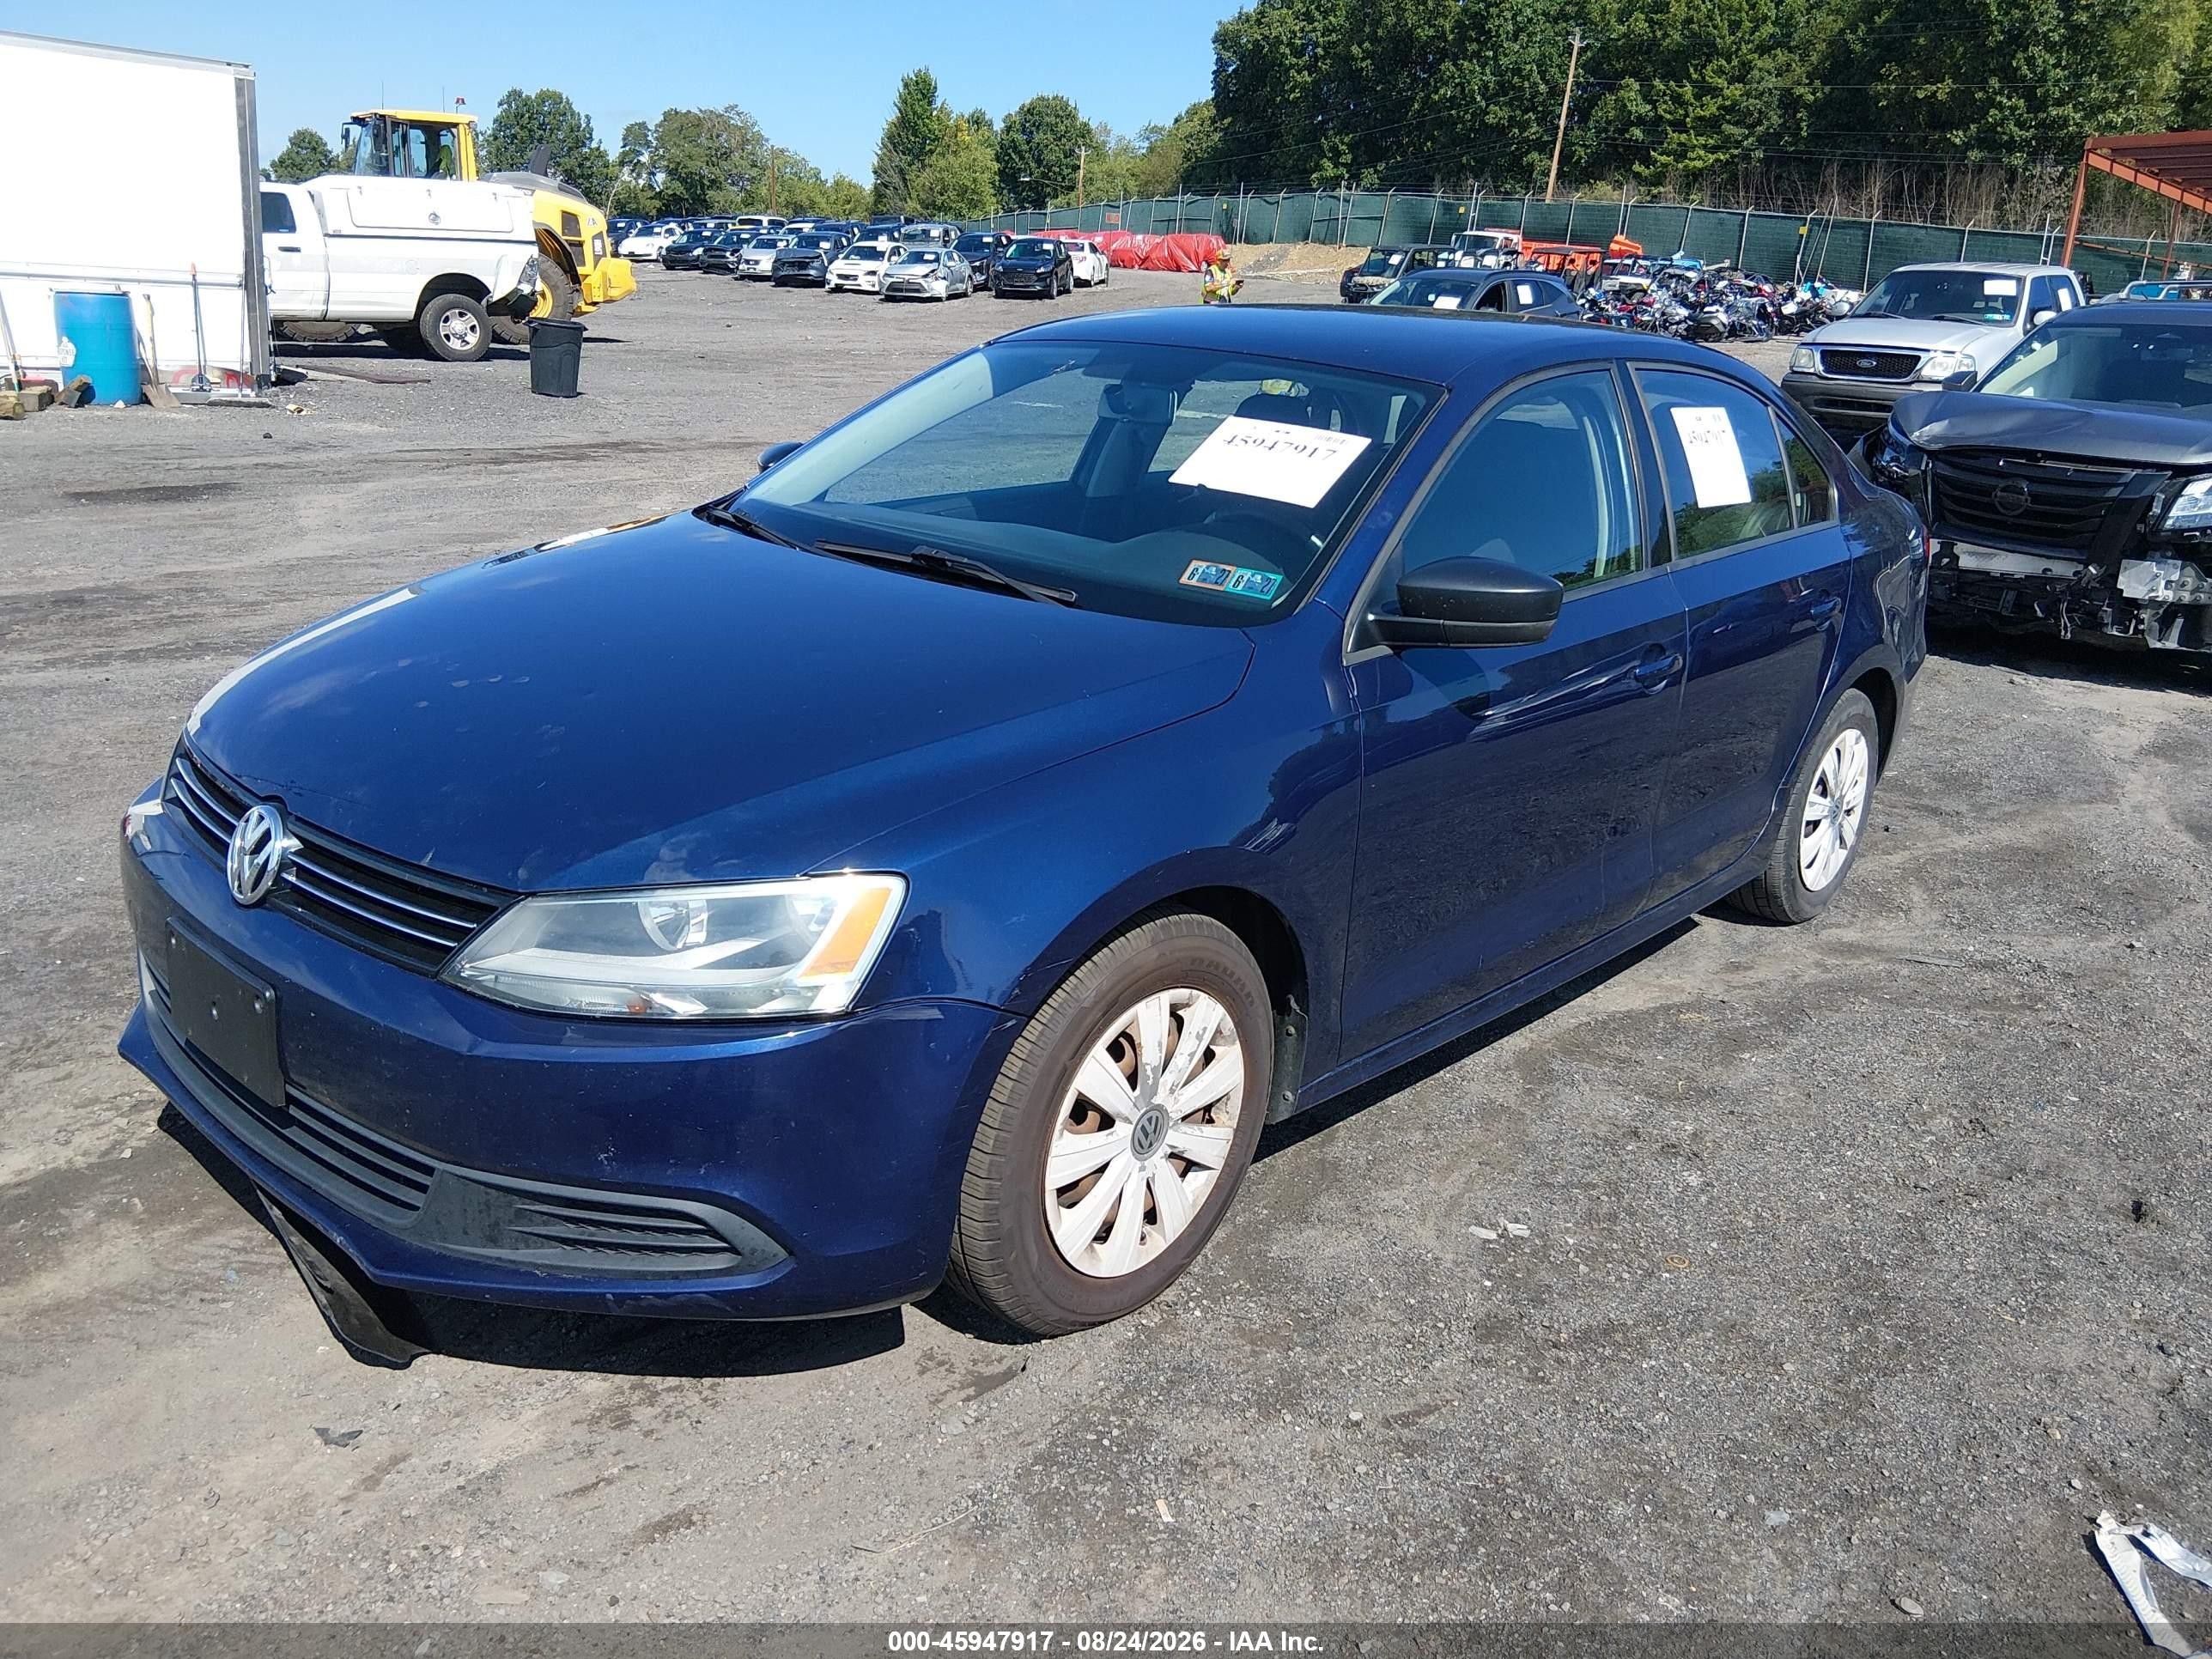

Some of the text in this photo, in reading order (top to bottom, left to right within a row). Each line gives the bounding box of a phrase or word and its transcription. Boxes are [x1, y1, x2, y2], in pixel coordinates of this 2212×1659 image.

[1223, 434, 1337, 460] 45947917
[1215, 568, 1231, 586] 27
[1261, 577, 1278, 594] 27
[230, 809, 279, 901] VW
[1134, 1113, 1164, 1152] VW
